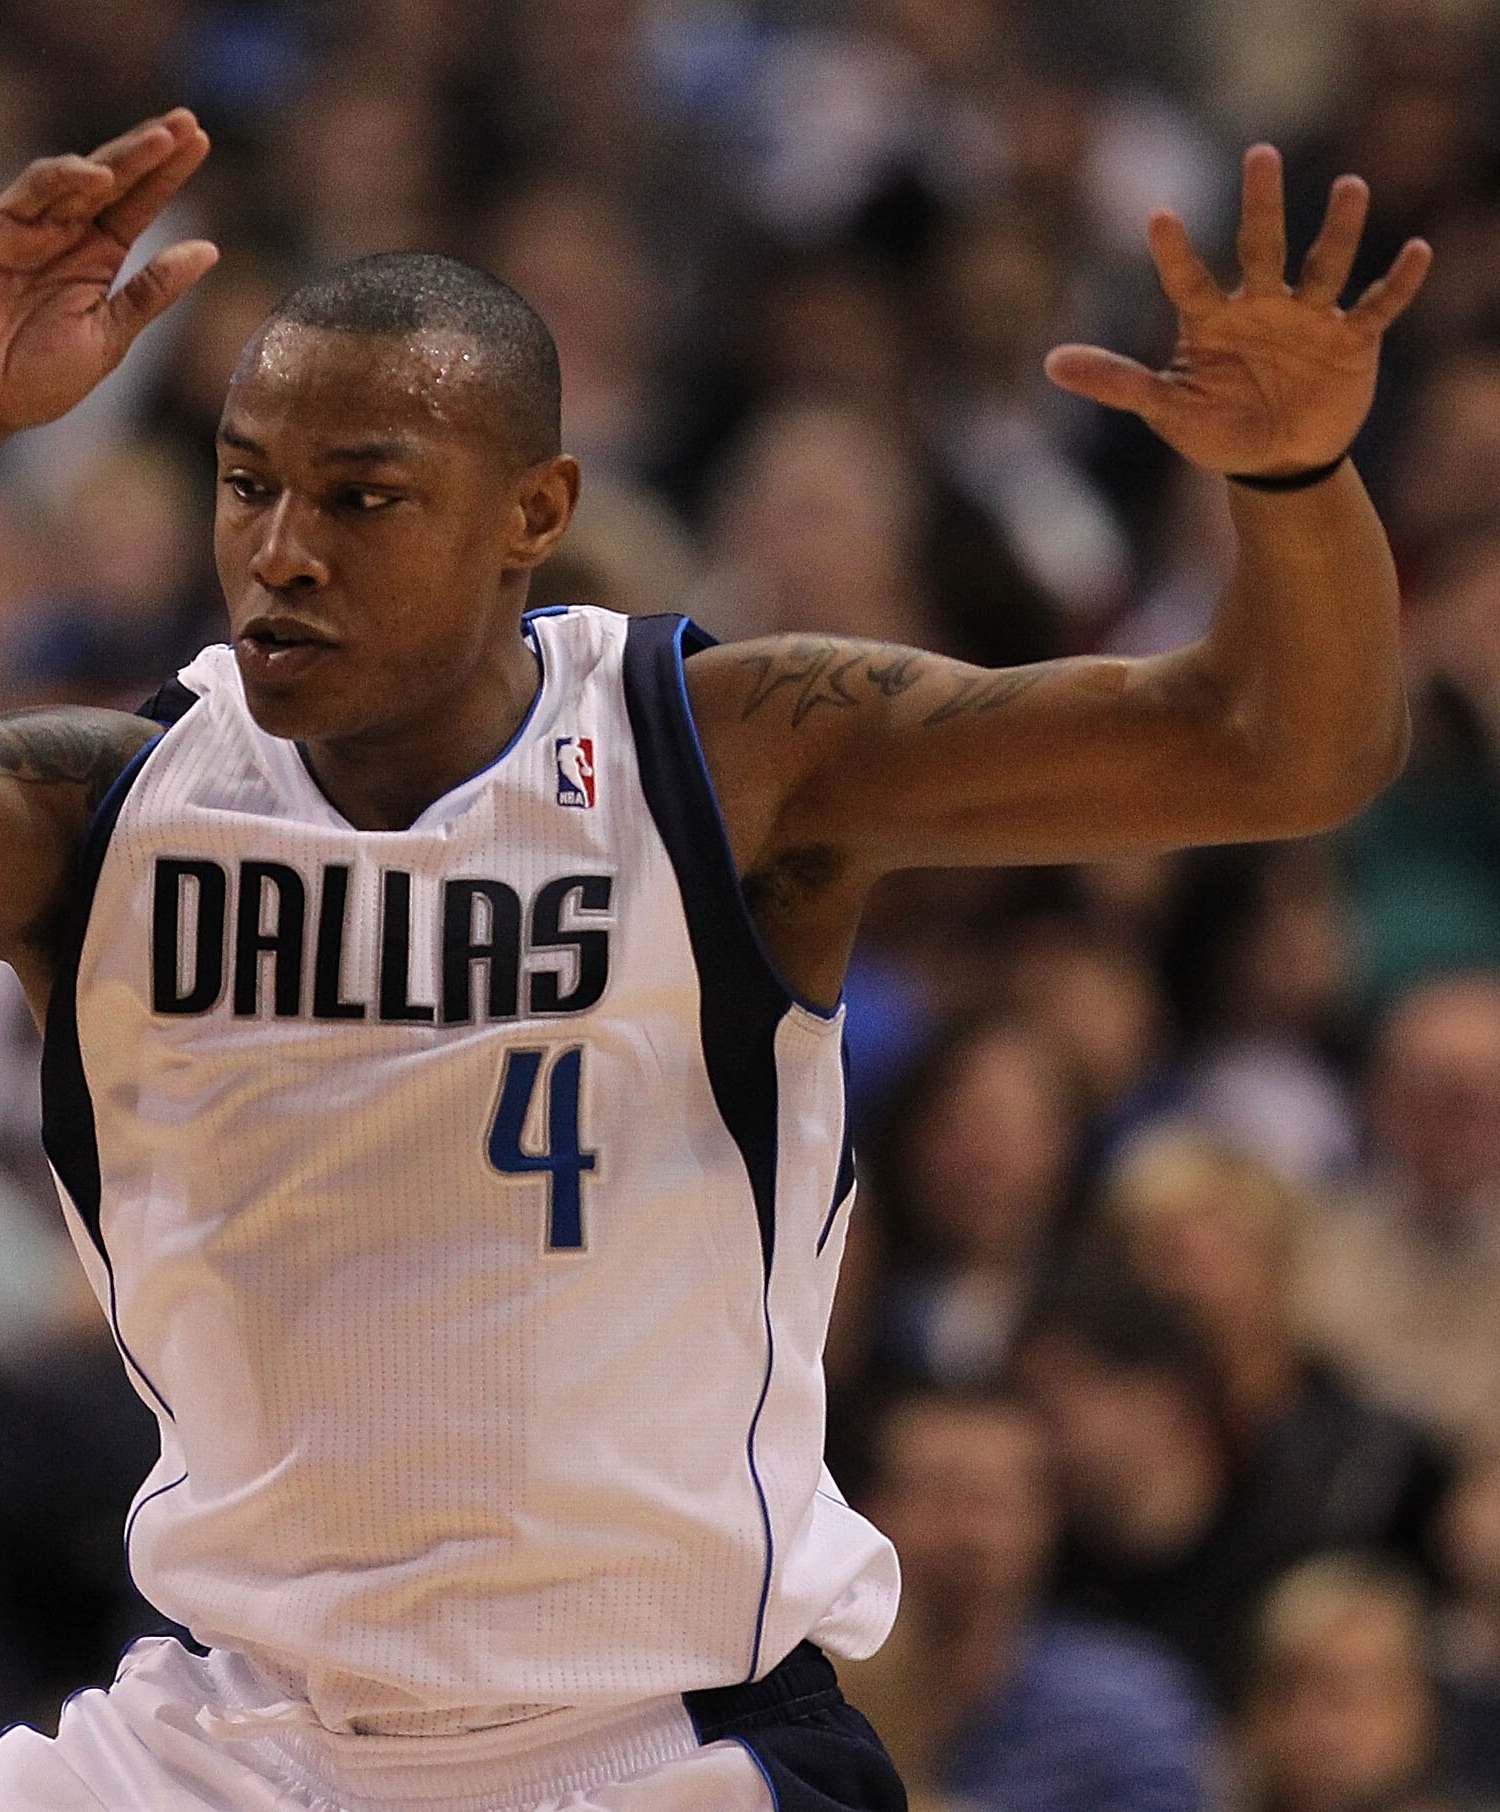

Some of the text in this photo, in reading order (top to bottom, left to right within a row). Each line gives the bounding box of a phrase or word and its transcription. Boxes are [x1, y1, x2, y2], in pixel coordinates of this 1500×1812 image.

[560, 791, 584, 805] NBA
[150, 856, 615, 1027] DALLAS
[484, 1041, 598, 1253] 4
